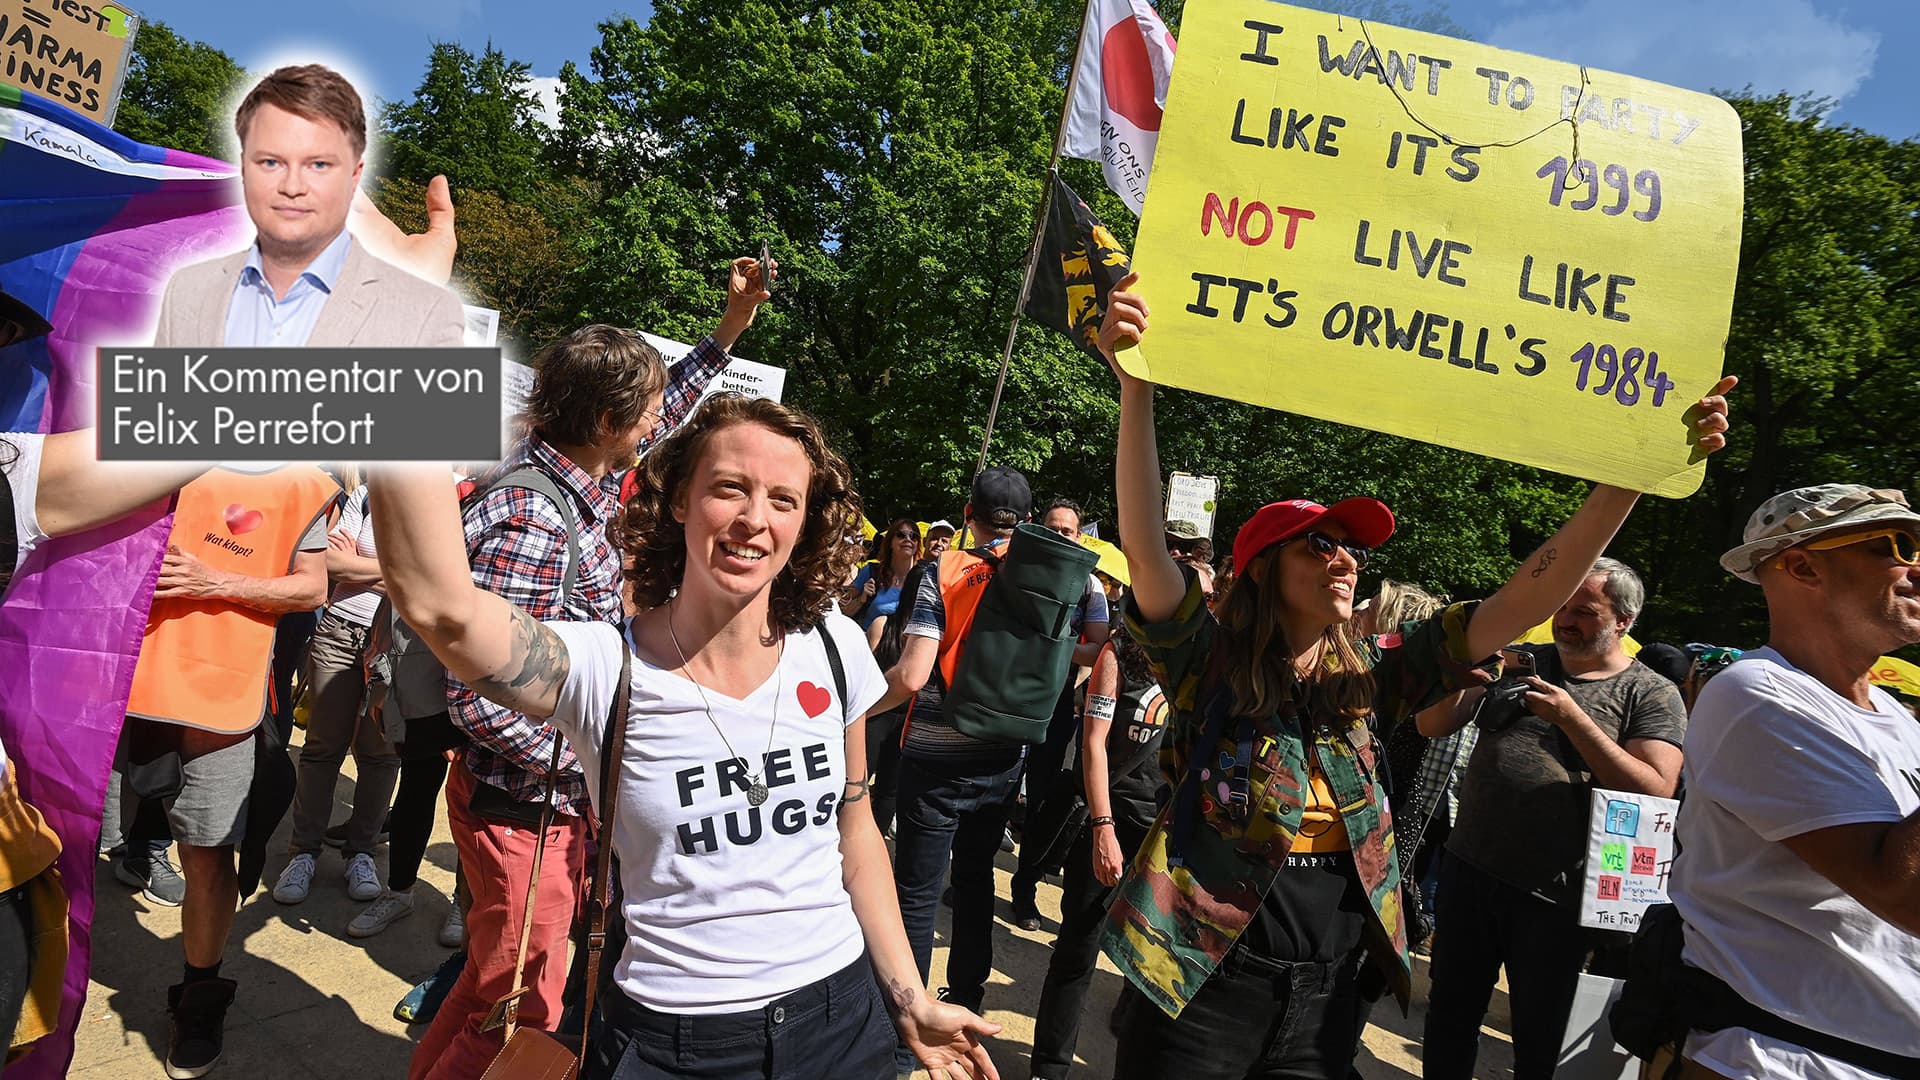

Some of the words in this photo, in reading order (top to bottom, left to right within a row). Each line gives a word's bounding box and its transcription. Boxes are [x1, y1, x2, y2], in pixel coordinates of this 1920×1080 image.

[0, 51, 99, 112] iNESS
[1240, 20, 1284, 65] I
[1317, 34, 1452, 96] WANT
[1476, 67, 1535, 110] TO
[1560, 85, 1700, 144] PARTY
[1118, 142, 1146, 179] ONS
[1230, 98, 1346, 157] LIKE
[1536, 155, 1662, 222] 1999
[1201, 192, 1316, 250] NOT
[1354, 219, 1472, 287] LIVE
[1518, 254, 1636, 322] LIKE
[1186, 272, 1298, 328] IT'S
[1322, 301, 1547, 377] ORWELL'S
[1570, 342, 1675, 408] 1984
[721, 368, 763, 383] Kinder-
[203, 532, 223, 546] Wat
[222, 539, 254, 557] klopt?
[676, 742, 831, 807] FREE
[676, 792, 836, 855] HUGS
[1288, 856, 1337, 867] HAPPY
[1604, 851, 1624, 867] vrt
[1633, 851, 1655, 865] vtm
[1601, 879, 1620, 898] HLN
[1596, 910, 1615, 925] THE
